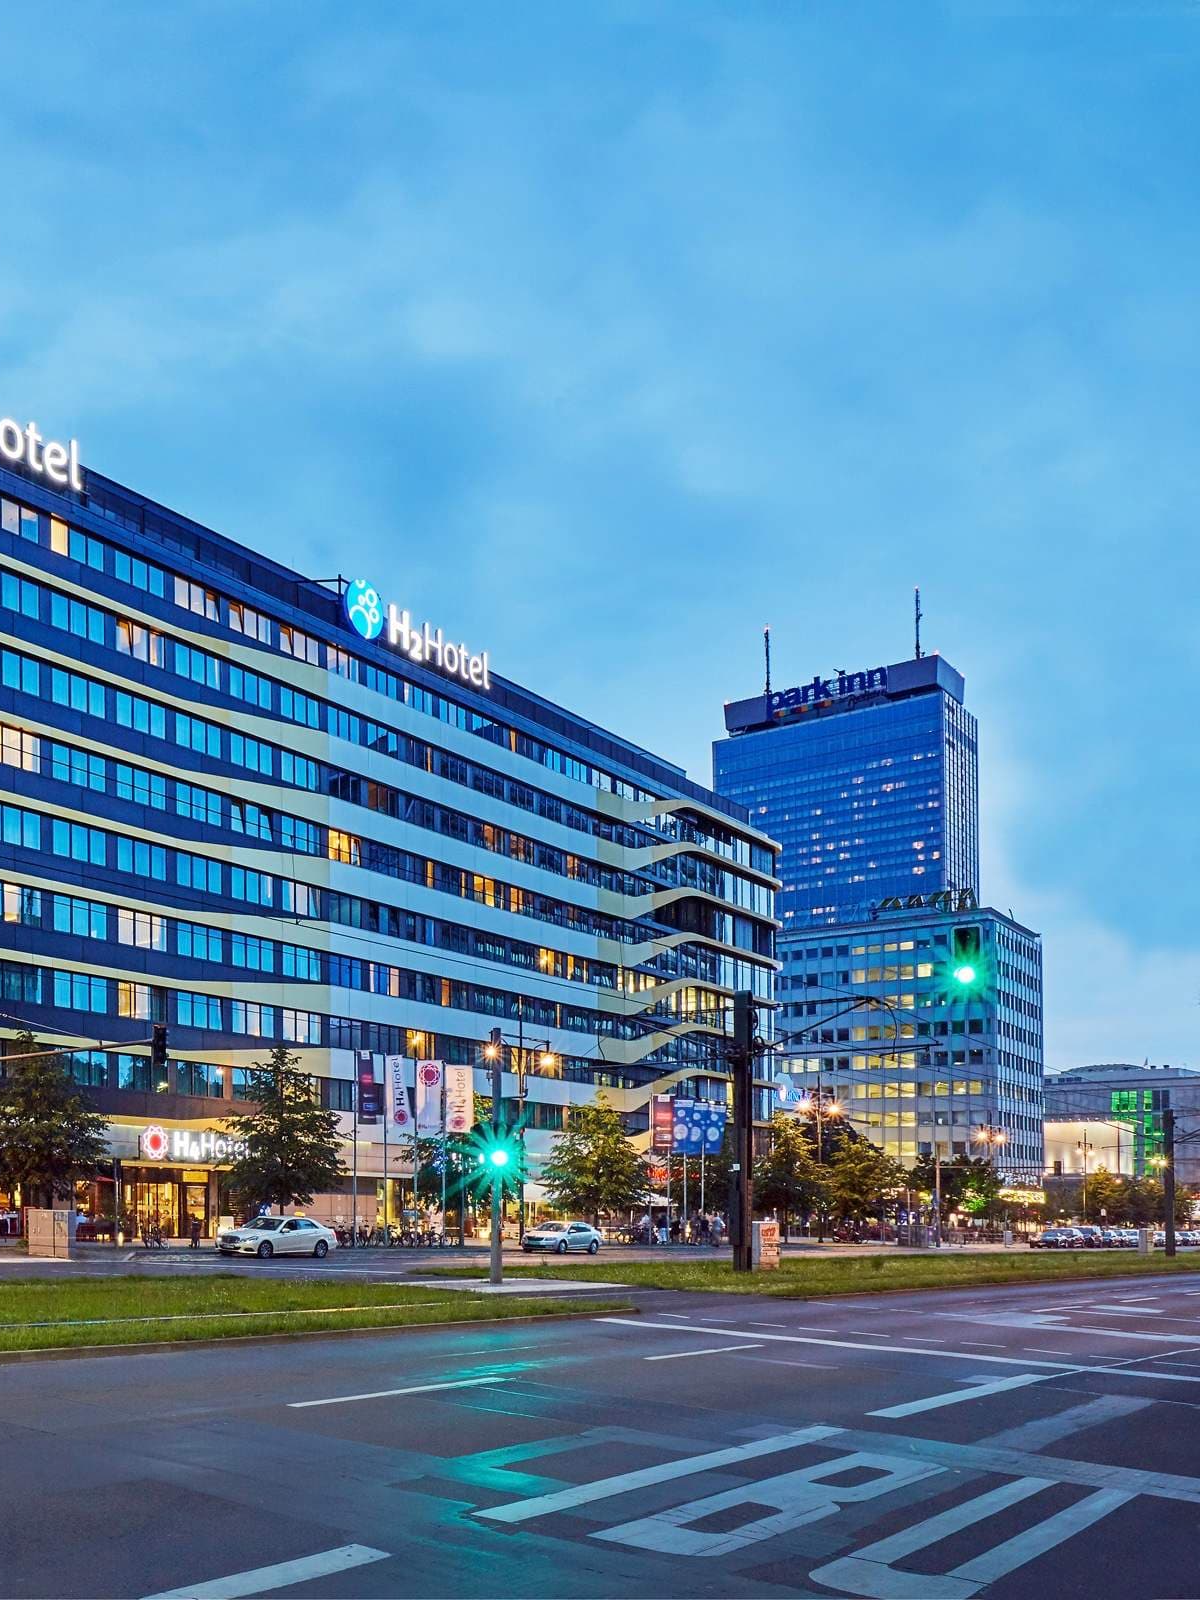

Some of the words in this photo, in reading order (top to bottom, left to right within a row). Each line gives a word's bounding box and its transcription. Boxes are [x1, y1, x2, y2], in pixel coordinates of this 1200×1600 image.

[388, 603, 490, 691] H2Hotel
[766, 676, 833, 719] park
[834, 667, 887, 697] inn
